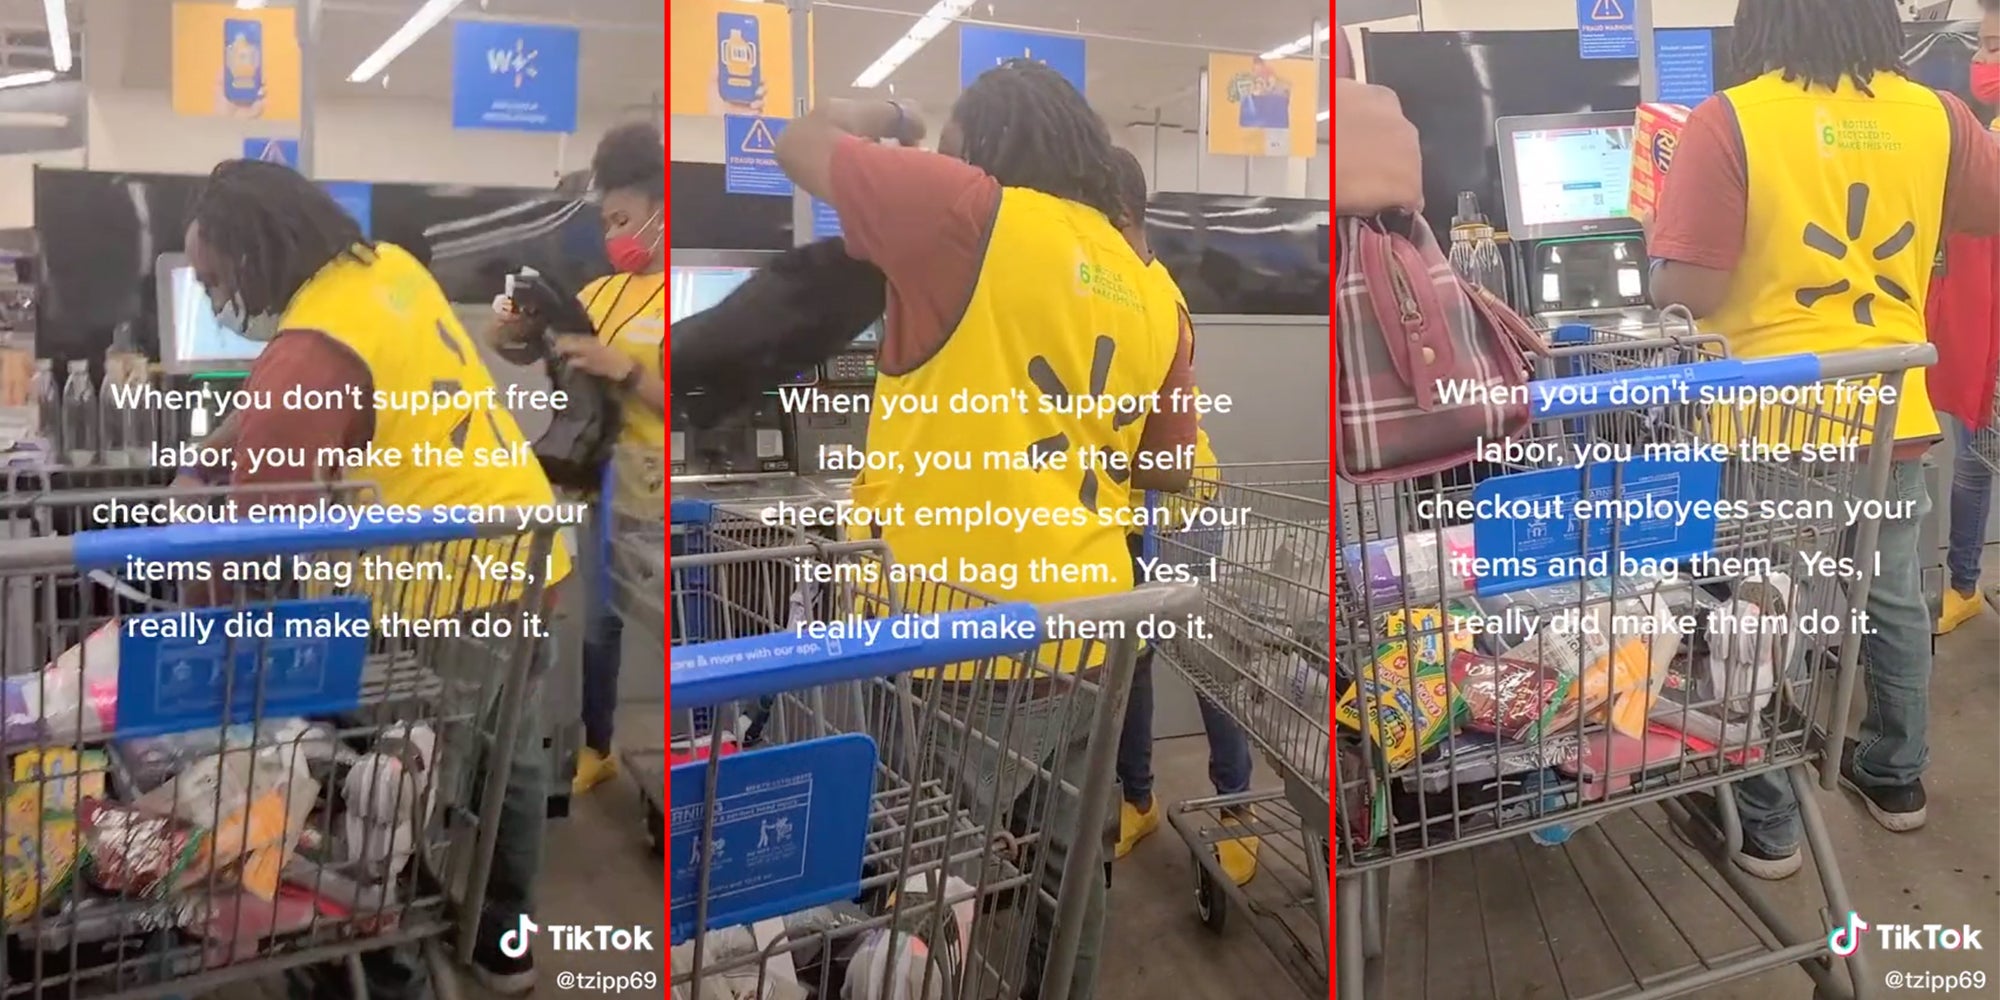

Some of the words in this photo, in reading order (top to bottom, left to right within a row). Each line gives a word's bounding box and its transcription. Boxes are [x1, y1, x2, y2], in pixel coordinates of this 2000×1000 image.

[1823, 126, 1835, 146] 6
[1654, 128, 1676, 172] RITZ
[1079, 262, 1091, 284] 6
[711, 654, 744, 665] more
[745, 647, 772, 661] with
[774, 646, 794, 657] our
